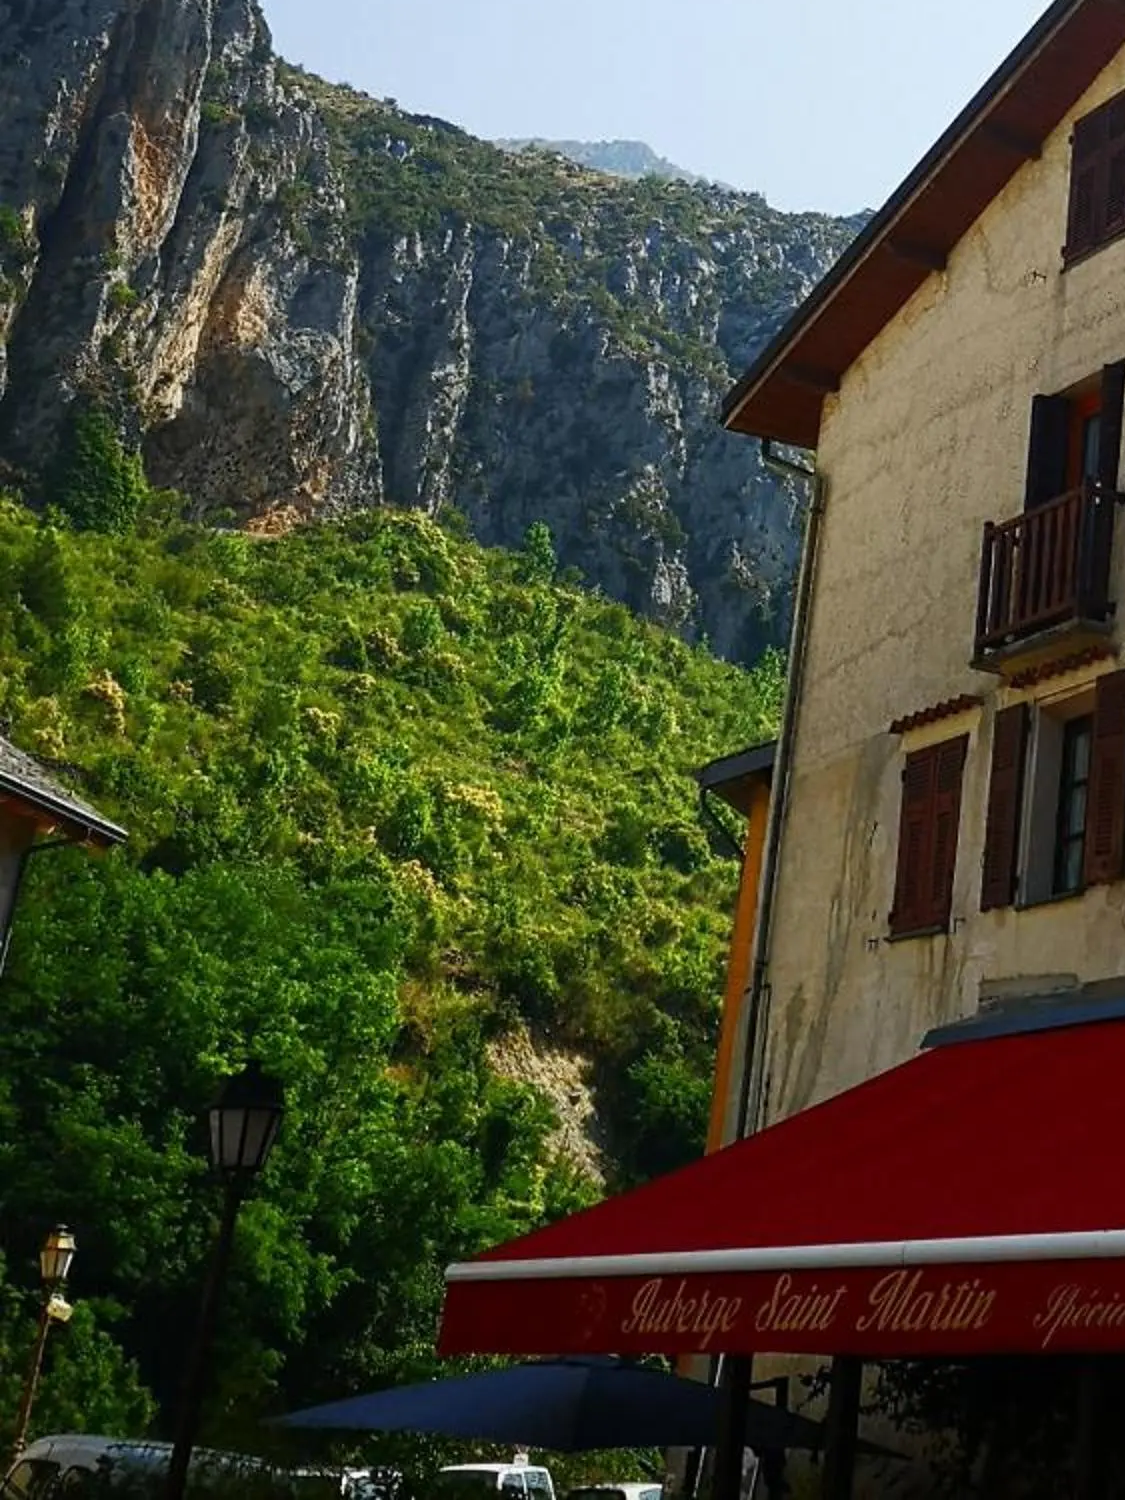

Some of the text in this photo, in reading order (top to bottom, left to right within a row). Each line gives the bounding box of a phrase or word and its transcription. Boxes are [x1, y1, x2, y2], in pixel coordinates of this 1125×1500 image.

[620, 1268, 997, 1351] Auberge Saint Martin
